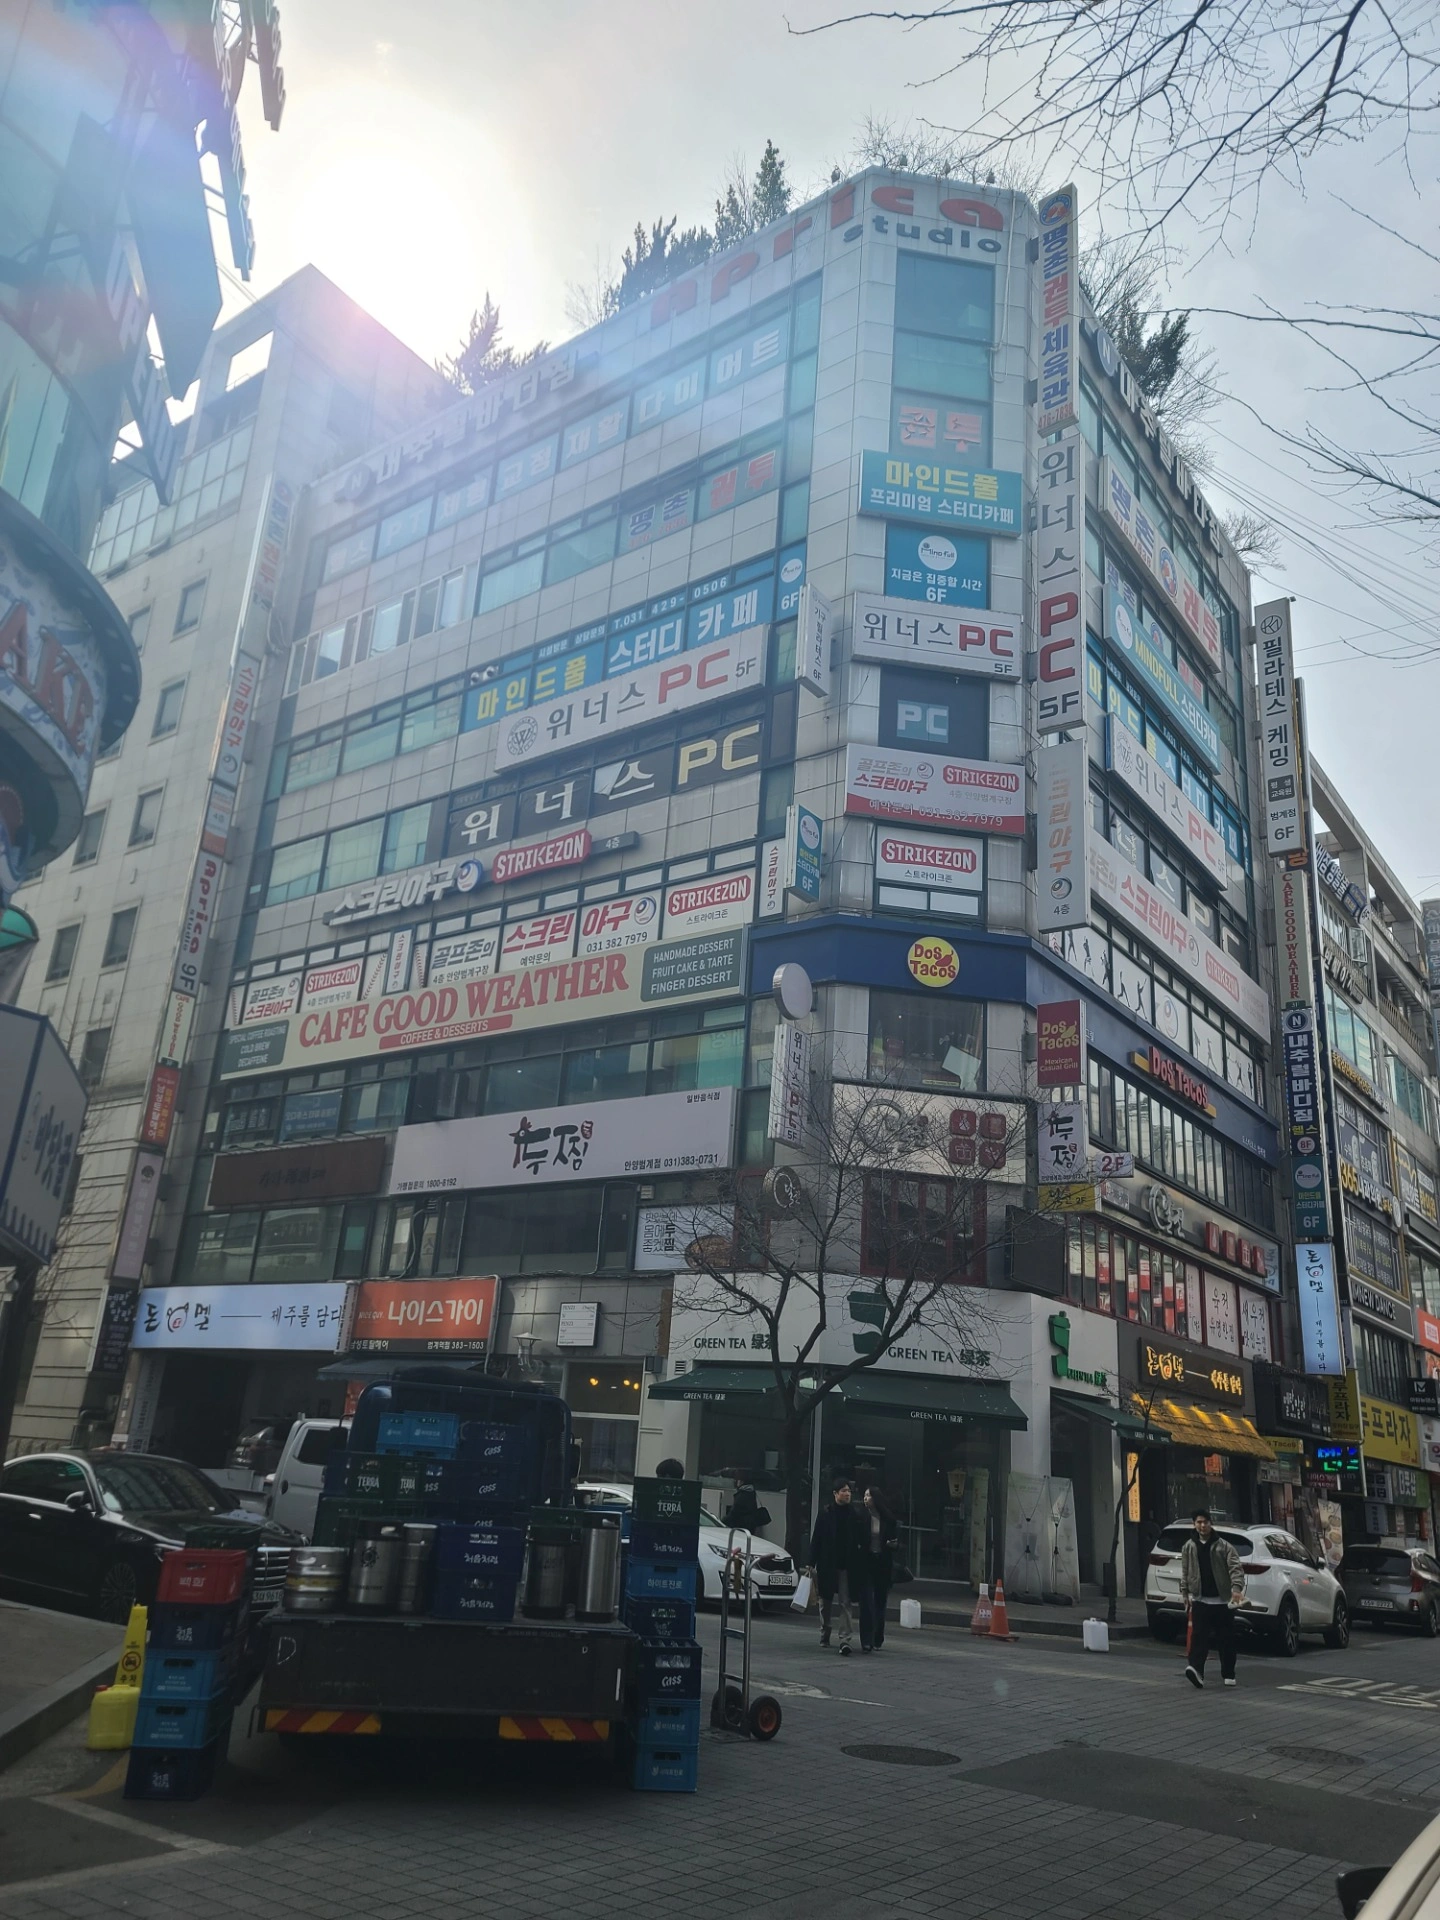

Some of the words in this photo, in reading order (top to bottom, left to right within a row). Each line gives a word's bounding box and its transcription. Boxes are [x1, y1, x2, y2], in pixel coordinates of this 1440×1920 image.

[843, 215, 1001, 254] studio
[1042, 222, 1070, 410] 평촌권투체육관
[710, 450, 774, 509] 권투
[886, 460, 999, 501] 마인드풀
[870, 488, 931, 513] 프리미엄
[937, 498, 1015, 525] 스터디카페
[1111, 469, 1155, 558] 평촌
[1183, 580, 1219, 655] 권투
[694, 577, 728, 598] 0506
[891, 568, 922, 583] 지금은
[926, 572, 958, 588] 집중할
[961, 577, 983, 592] 시간
[780, 591, 800, 610] 6F
[926, 588, 948, 603] 6F
[735, 657, 758, 679] 5F
[994, 662, 1014, 675] 5F
[1262, 636, 1289, 718] 필라테스
[477, 655, 587, 721] 마인드풀
[1135, 633, 1180, 705] MINDFULL
[1180, 699, 1218, 767] 스터디카페
[1039, 691, 1079, 720] 5F
[899, 704, 949, 737] PC
[1267, 724, 1290, 768] 케밍
[854, 773, 929, 795] 스크린야구
[857, 757, 913, 776] 골프존의
[946, 769, 1018, 792] STRIKEZON
[869, 799, 915, 816] 예약문의
[919, 805, 1004, 827] 031.382.7979
[1270, 808, 1297, 822] 범계점
[1274, 825, 1295, 841] 6F
[886, 841, 973, 872] STRIKEZON
[328, 864, 457, 926] 스크린야구
[496, 833, 584, 880] STRIKEZON
[802, 875, 814, 893] 6F
[904, 870, 954, 884] 스트라이크존
[671, 879, 748, 912] STRIKEZON
[1282, 873, 1295, 908] CAFE
[503, 913, 576, 954] 스크린
[581, 900, 634, 937] 야구
[686, 908, 729, 926] 스트라이크존
[1120, 875, 1189, 955] 스크린야구
[1284, 909, 1298, 942] GOOD
[431, 939, 497, 970] 골프존의
[586, 942, 604, 953] 031
[605, 937, 624, 949] 382
[625, 931, 648, 945] 7979
[653, 946, 697, 963] HANDMADE
[698, 937, 735, 955] DESSERT
[914, 944, 943, 960] Dos
[520, 950, 552, 966] 예약문의
[651, 965, 676, 980] FRUIT
[676, 959, 698, 974] CAKE
[699, 958, 706, 971] &
[707, 954, 734, 969] TARTE
[909, 959, 956, 978] Tacos
[1285, 942, 1301, 999] WEATHER
[178, 962, 202, 995] 9F
[307, 966, 358, 992] STRIKEZON
[650, 978, 686, 995] FINGER
[687, 970, 733, 988] DESSERT
[244, 999, 294, 1020] 스크린야구
[300, 1004, 369, 1049] CAFE
[373, 987, 460, 1035] GOOD
[466, 953, 630, 1019] WEATHER
[400, 1029, 434, 1045] COFFEE
[435, 1028, 442, 1040] &
[443, 1020, 489, 1037] DESSERTS
[1042, 1021, 1066, 1036] Dos
[1039, 1034, 1080, 1050] Tacos
[1040, 1064, 1063, 1072] Casual
[1064, 1062, 1079, 1071] Grill
[1045, 1057, 1074, 1066] Mexican
[1149, 1046, 1175, 1086] Dos
[1175, 1062, 1210, 1109] Tacos
[1288, 1033, 1314, 1122] 내추럴바디짐
[686, 1091, 721, 1104] 일반음식점
[624, 1157, 662, 1172] 안양범계점
[663, 1152, 719, 1168] 031)383-0731
[1101, 1154, 1124, 1172] 2F
[1303, 1216, 1320, 1229] 6F
[271, 1305, 310, 1329] 제주를
[388, 1298, 484, 1327] 나이스가이
[452, 1341, 484, 1351] 383-1503
[693, 1337, 726, 1350] GREEN
[728, 1337, 747, 1350] TEA
[888, 1346, 928, 1361] GREEN
[931, 1350, 955, 1364] TEA
[683, 1392, 702, 1401] GREEN
[703, 1392, 714, 1401] TEA
[910, 1410, 932, 1421] GREEN
[934, 1412, 947, 1422] TEA
[657, 1501, 682, 1514] TERRA
